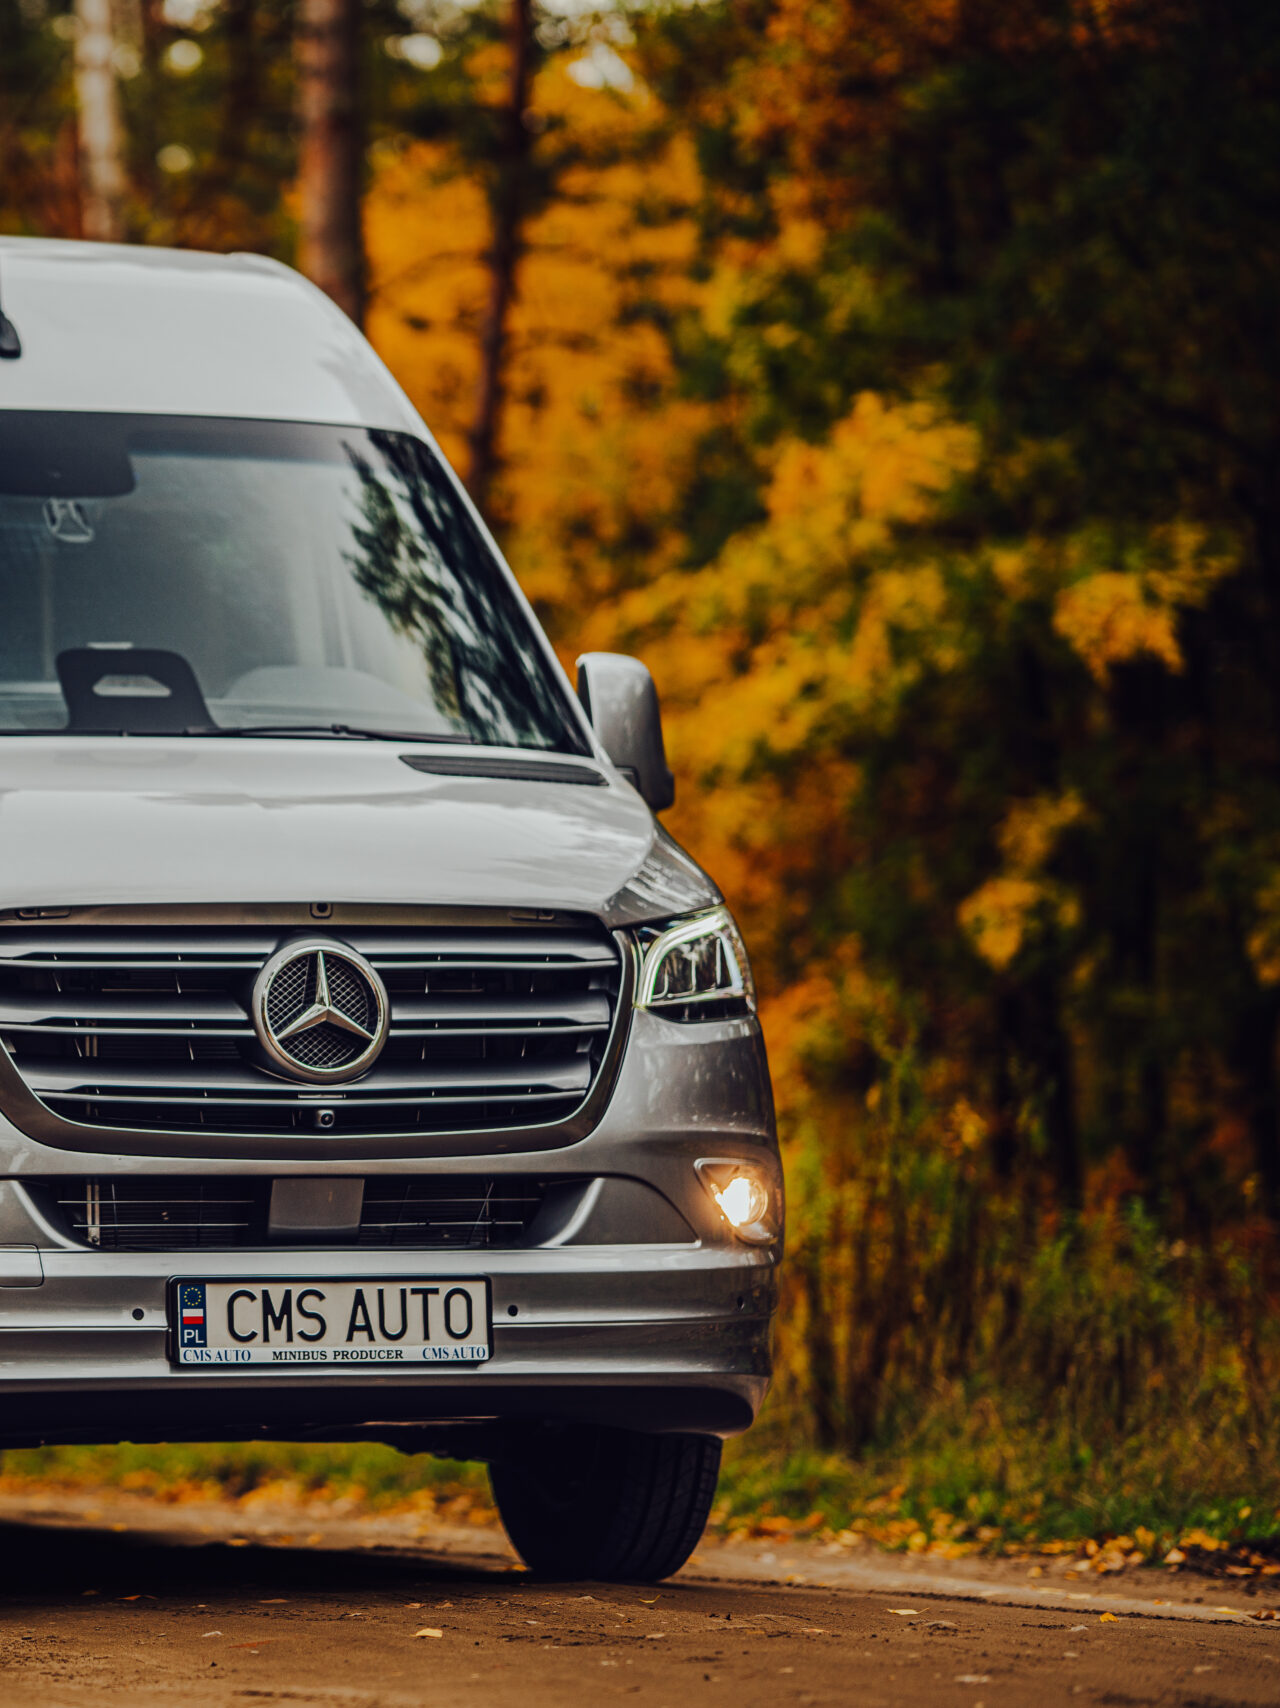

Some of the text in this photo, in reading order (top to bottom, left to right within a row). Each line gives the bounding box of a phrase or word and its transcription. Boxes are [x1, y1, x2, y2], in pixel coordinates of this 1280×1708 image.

[227, 1287, 473, 1343] CMS AUTO
[183, 1329, 204, 1344] PL
[183, 1349, 251, 1362] CMS AUTO
[271, 1348, 404, 1361] MINIBUS PRODUCER
[422, 1346, 486, 1360] CMS AUTO
